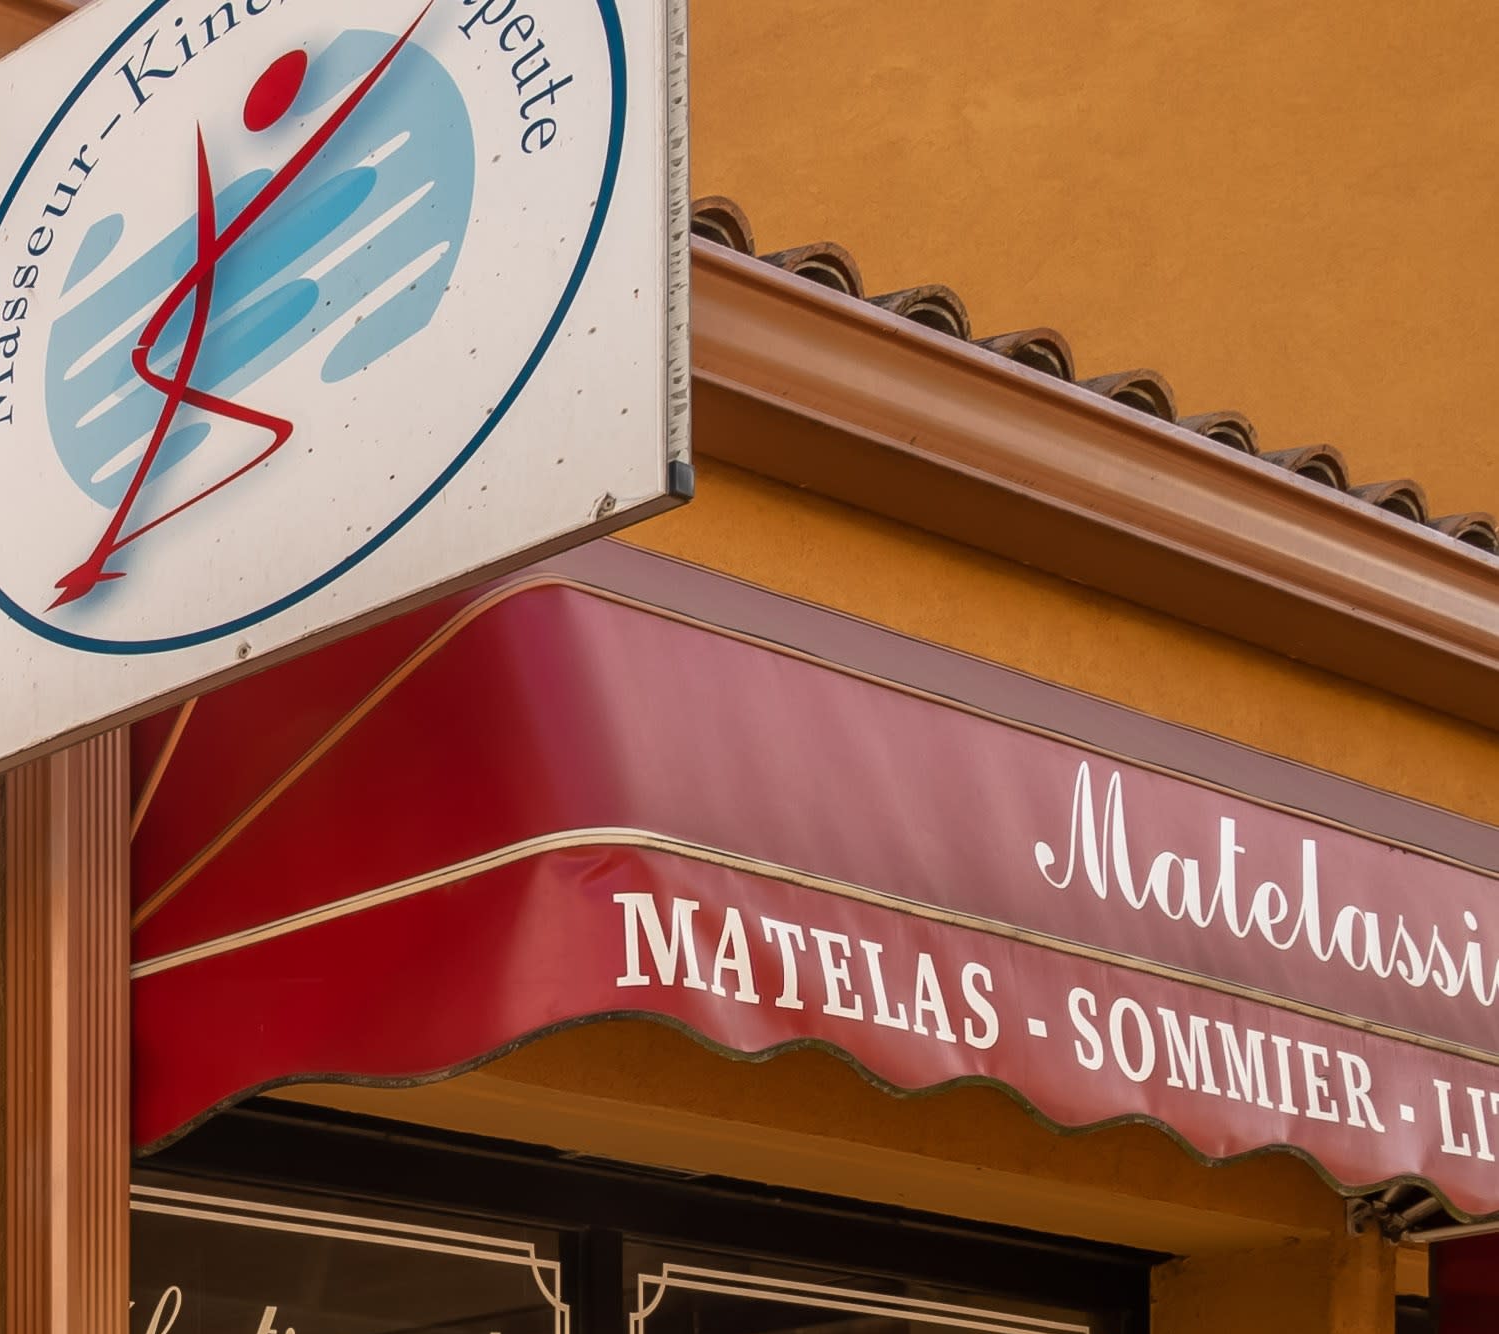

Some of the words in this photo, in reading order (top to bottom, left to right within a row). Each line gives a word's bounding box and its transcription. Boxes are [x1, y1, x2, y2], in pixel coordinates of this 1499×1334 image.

[1035, 760, 1499, 1007] Matelassi
[612, 890, 1001, 1051] MATELAS
[1066, 986, 1386, 1134] SOMMIER
